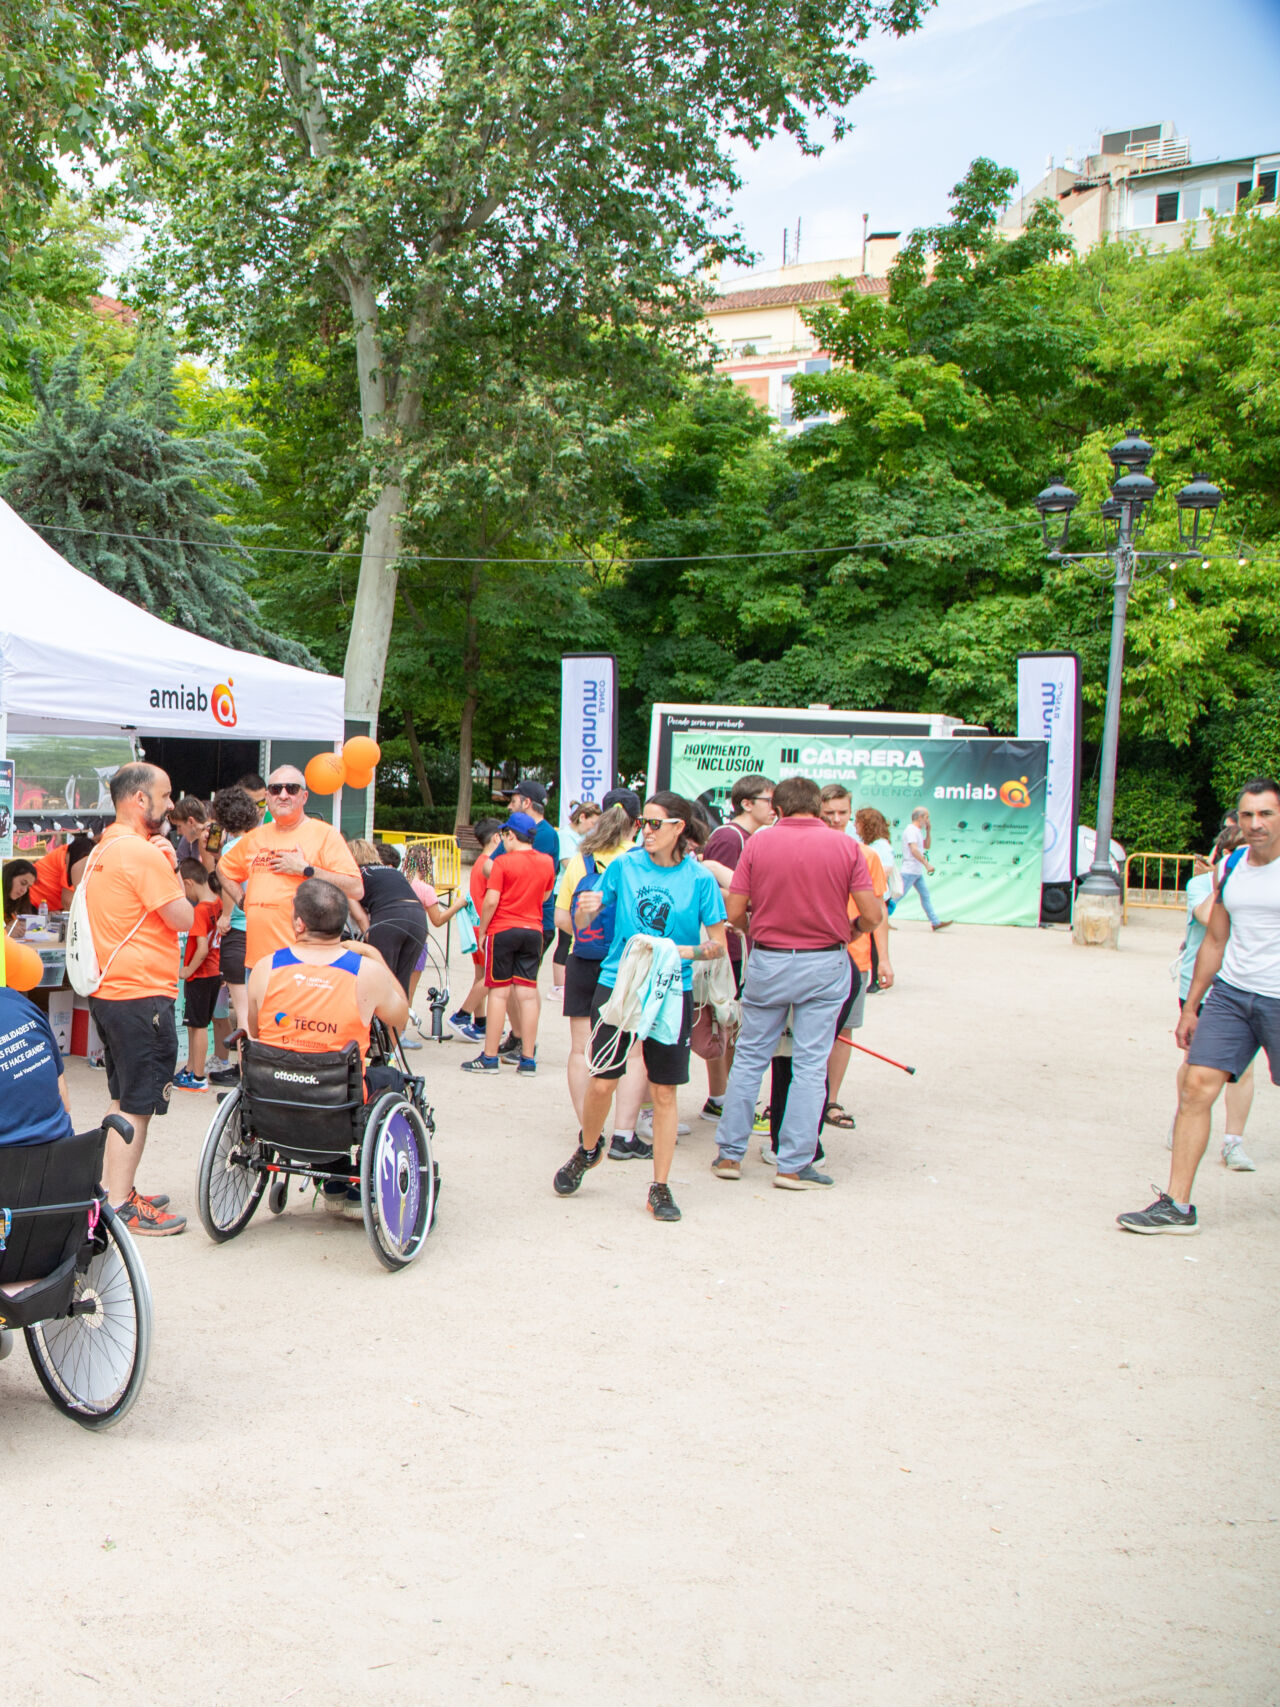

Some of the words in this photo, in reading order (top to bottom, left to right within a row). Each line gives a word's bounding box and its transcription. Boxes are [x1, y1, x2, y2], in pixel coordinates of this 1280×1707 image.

[149, 684, 208, 711] amiab
[684, 744, 751, 757] MOVIMIENTO
[780, 748, 799, 763] III
[800, 748, 925, 768] CARRERA
[697, 756, 765, 773] INCLUSIÓN
[779, 767, 858, 781] INCLUSIVA
[861, 769, 925, 787] 2025
[861, 787, 923, 799] CUENCA
[933, 782, 998, 800] amiab
[28, 1020, 37, 1030] TE
[295, 1019, 337, 1034] TECON
[4, 1039, 29, 1056] FUERTE,
[0, 1062, 9, 1073] TE
[9, 1054, 26, 1067] HACE
[274, 1070, 320, 1085] ottobock.
